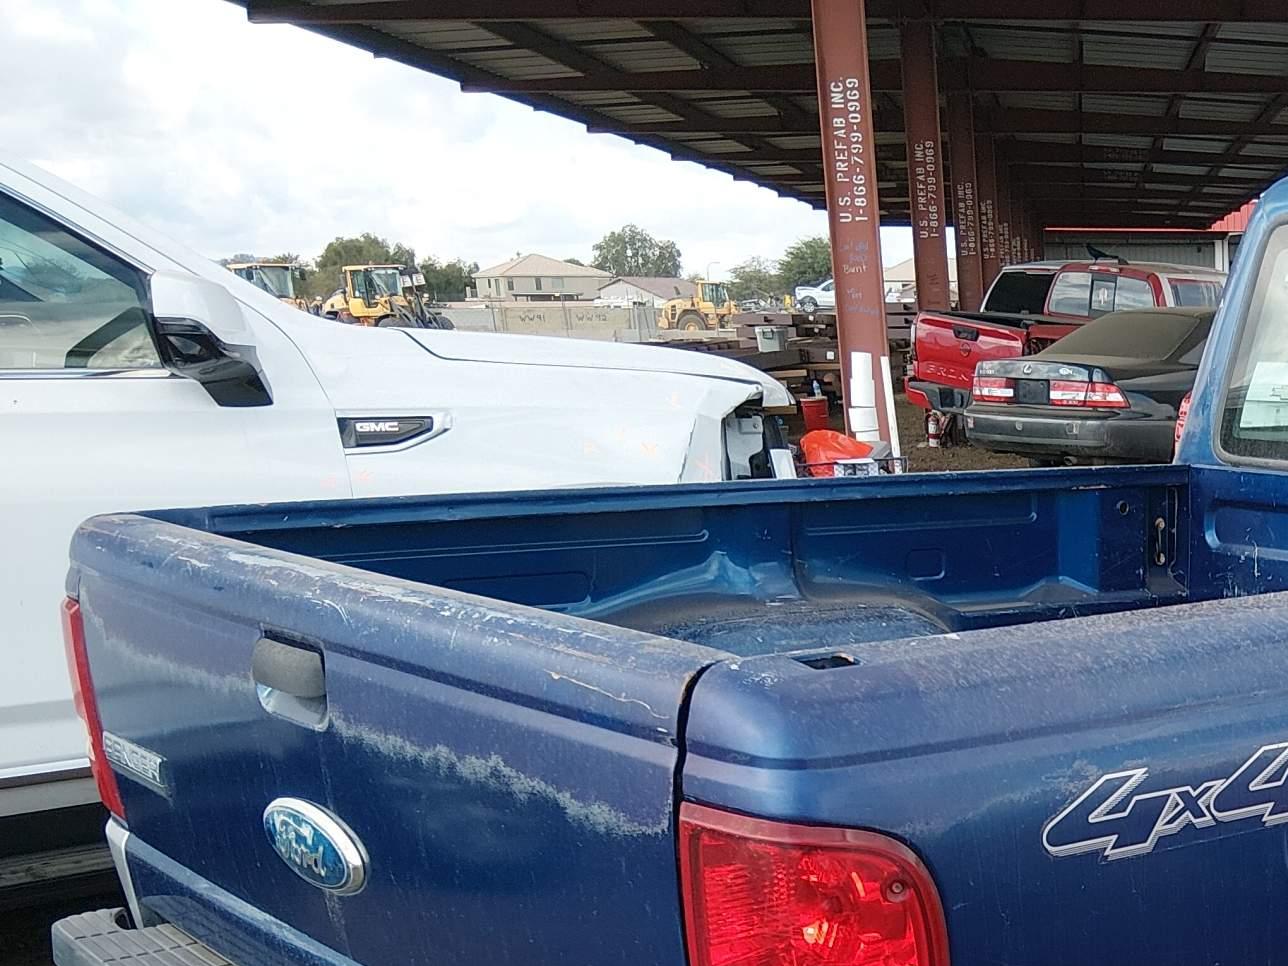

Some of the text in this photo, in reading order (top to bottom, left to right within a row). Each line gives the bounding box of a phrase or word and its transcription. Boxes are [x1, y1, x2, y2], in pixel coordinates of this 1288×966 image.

[830, 77, 853, 223] U.S. PREFAB INC.
[845, 78, 869, 222] 1-866-799-0969
[914, 140, 924, 161] INC.
[916, 167, 928, 211] PREFAB
[355, 421, 400, 432] GMC
[266, 809, 328, 879] Ford
